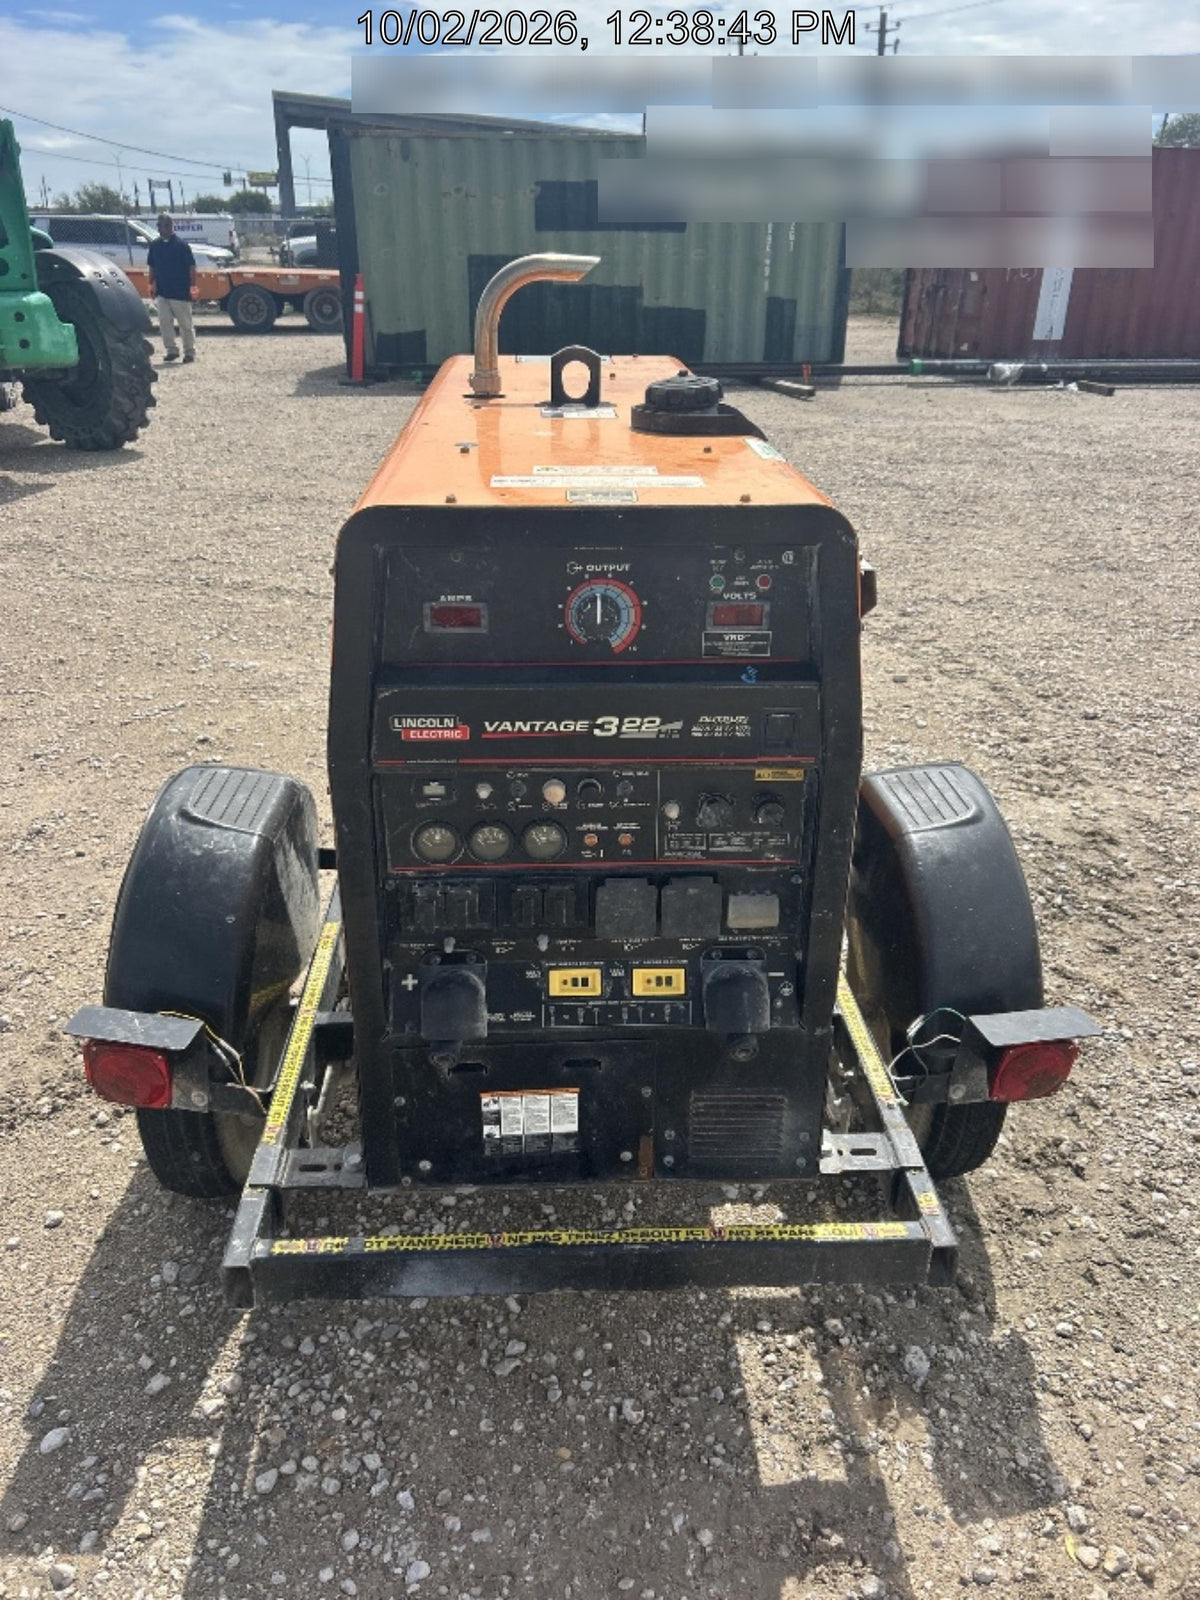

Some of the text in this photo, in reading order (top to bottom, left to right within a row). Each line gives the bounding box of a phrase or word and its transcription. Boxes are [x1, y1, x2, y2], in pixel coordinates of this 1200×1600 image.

[723, 592, 757, 600] VOLTS
[393, 717, 455, 728] LINCOLN
[483, 720, 590, 732] VANTAGE
[593, 715, 662, 737] 322
[409, 730, 463, 739] ELECTRIC
[443, 1236, 487, 1246] HERE
